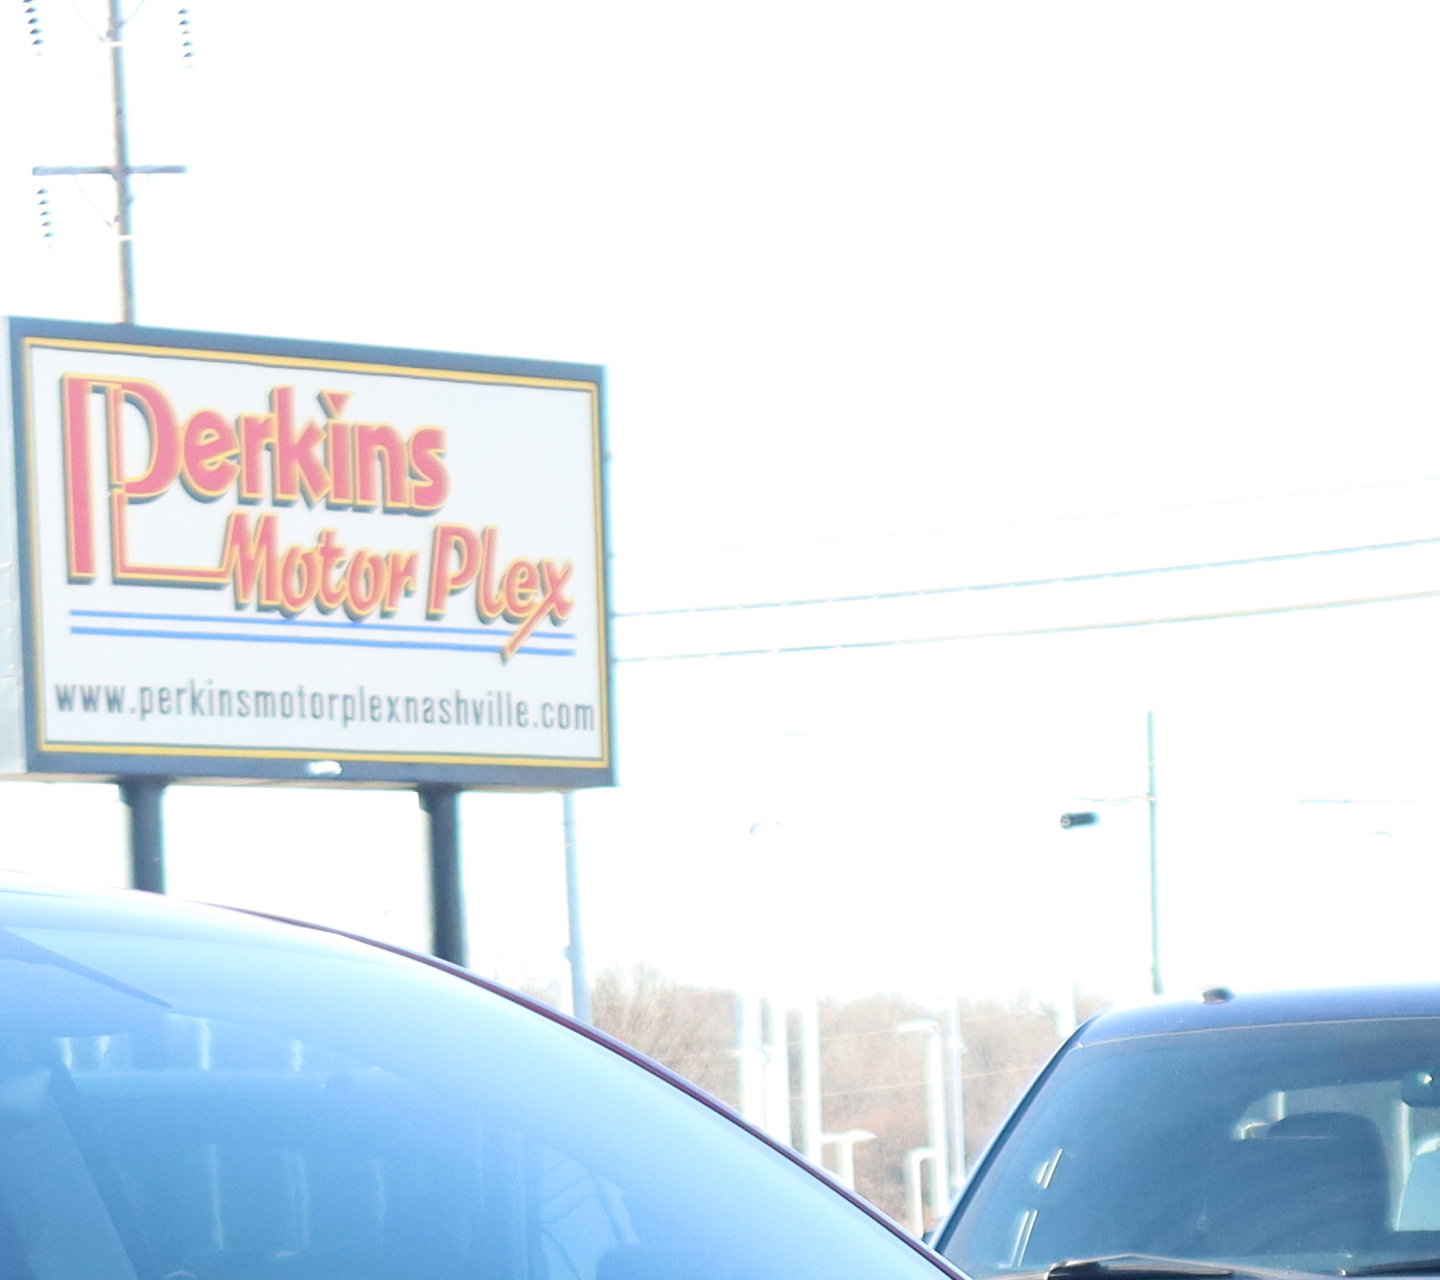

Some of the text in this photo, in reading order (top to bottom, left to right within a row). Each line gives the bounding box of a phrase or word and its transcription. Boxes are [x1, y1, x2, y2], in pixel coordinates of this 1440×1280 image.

[60, 372, 451, 584] Perkins
[221, 510, 576, 666] Motor Plex
[53, 679, 596, 732] www.perkinsmotorplexnashville.com
